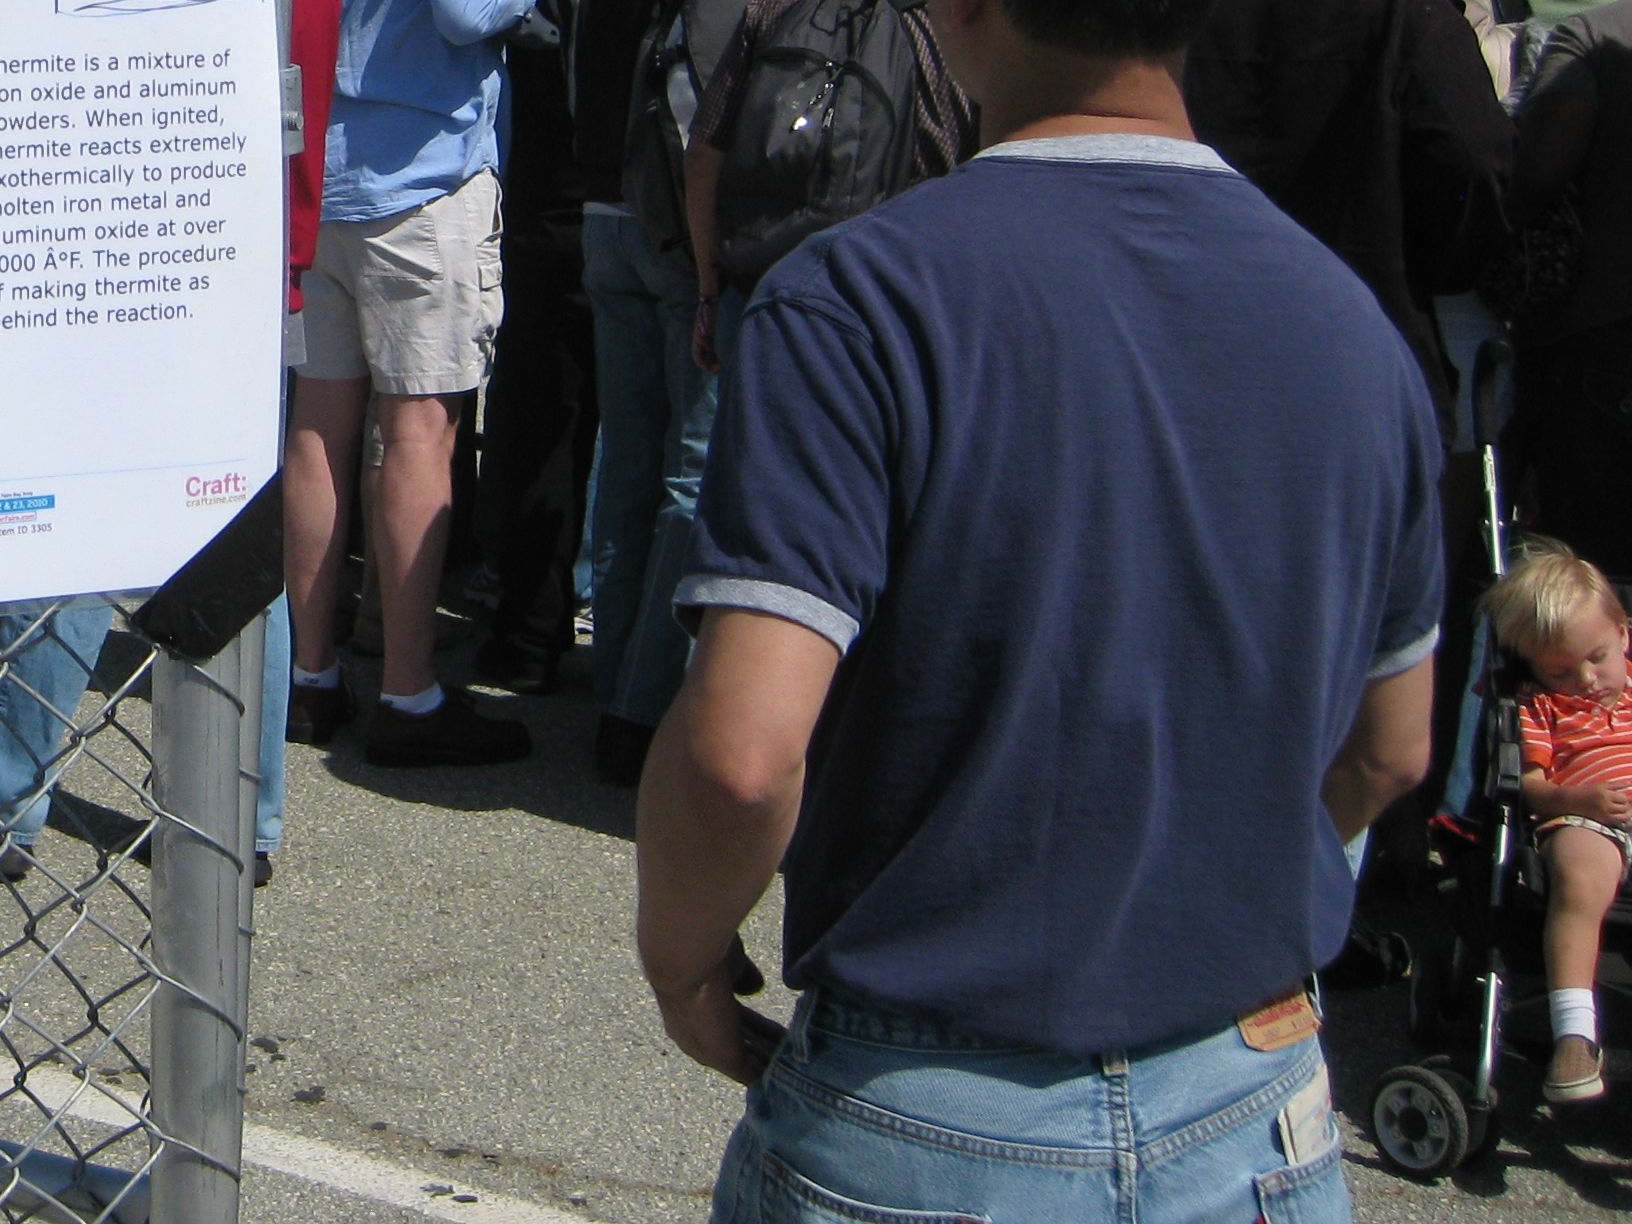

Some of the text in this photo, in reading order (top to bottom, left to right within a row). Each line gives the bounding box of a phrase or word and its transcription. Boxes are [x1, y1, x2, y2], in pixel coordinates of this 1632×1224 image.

[85, 54, 99, 71] is
[108, 57, 118, 71] a
[128, 52, 205, 70] mixture
[213, 49, 231, 67] of
[31, 82, 85, 101] oxide
[94, 80, 130, 99] and
[140, 79, 236, 98] aluminum
[86, 109, 142, 127] When
[152, 105, 224, 129] ignited,
[80, 138, 141, 156] reacts
[150, 132, 246, 153] extremely
[143, 165, 162, 181] to
[171, 161, 246, 184] produce
[64, 196, 101, 213] iron
[112, 192, 166, 210] metal
[176, 189, 210, 208] and
[95, 220, 148, 240] oxide
[157, 220, 176, 236] at
[184, 220, 226, 235] over
[93, 249, 130, 267] The
[139, 244, 236, 270] procedure
[12, 280, 86, 301] making
[95, 275, 181, 295] thermite
[189, 276, 209, 290] as
[66, 307, 98, 325] the
[108, 303, 193, 323] reaction.
[186, 472, 247, 497] Craft:
[17, 525, 28, 534] ID
